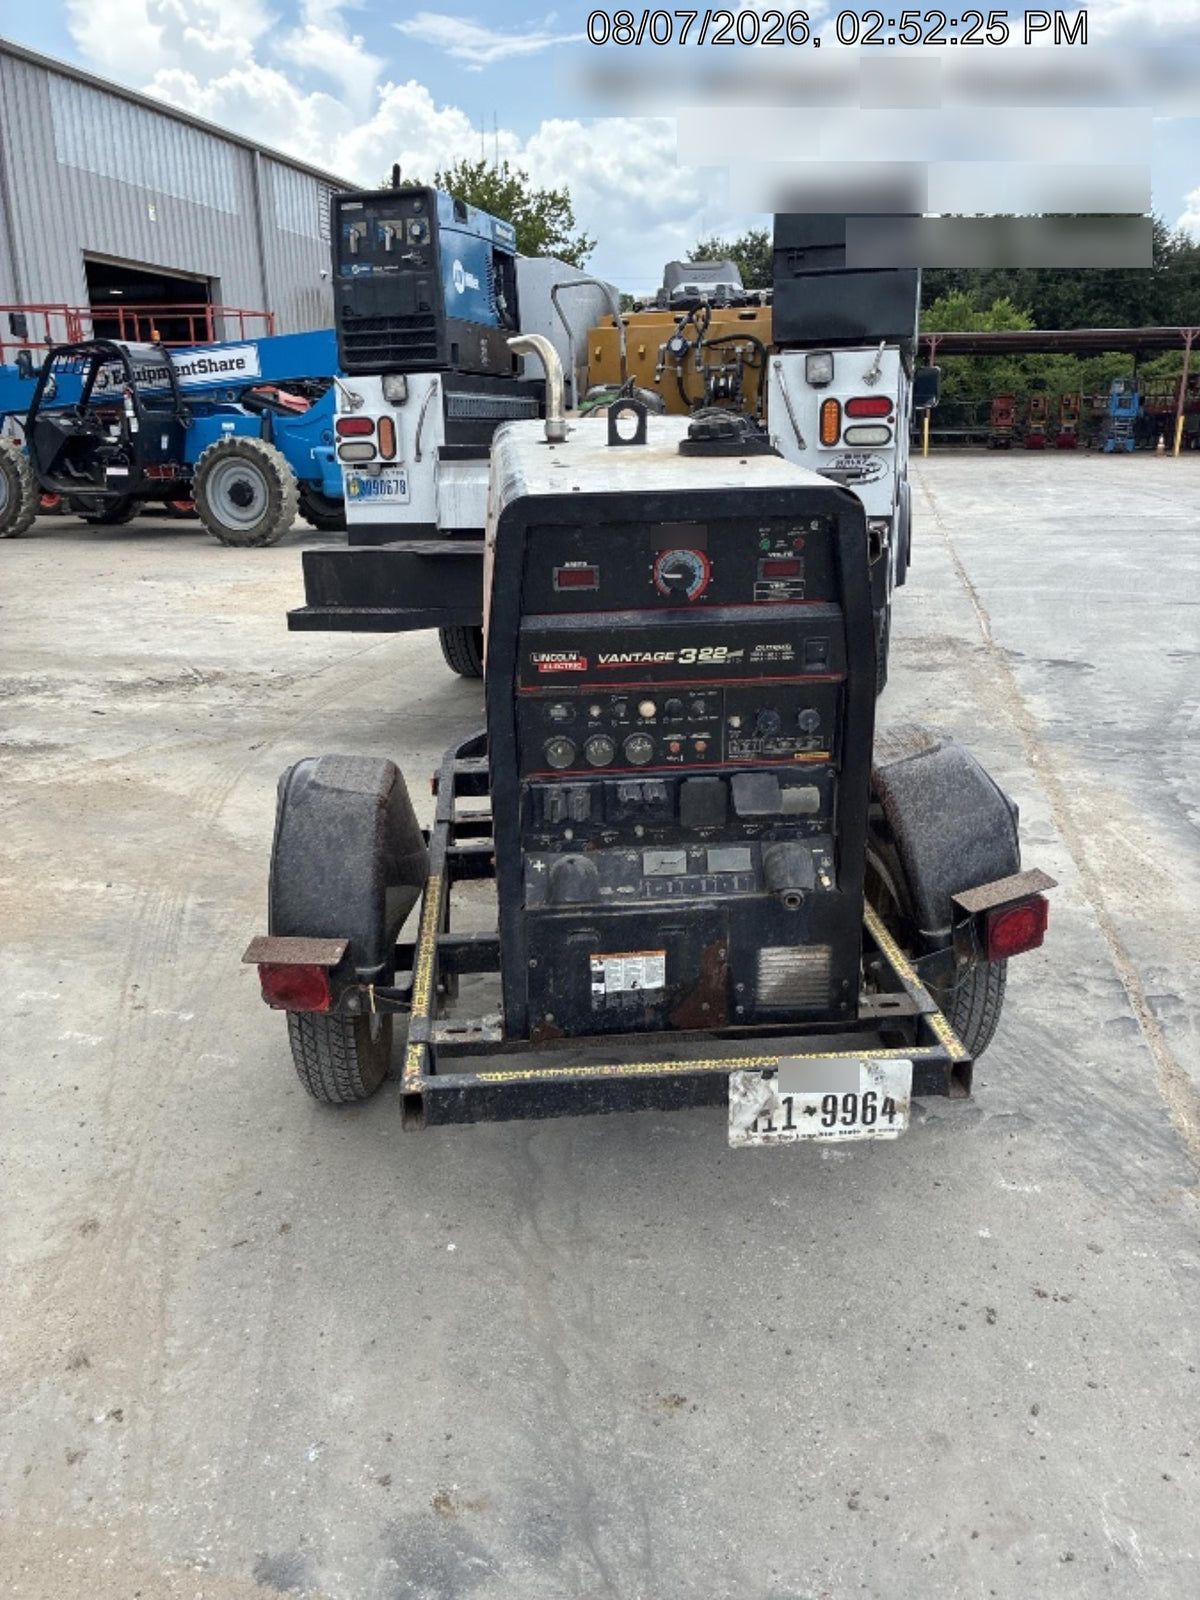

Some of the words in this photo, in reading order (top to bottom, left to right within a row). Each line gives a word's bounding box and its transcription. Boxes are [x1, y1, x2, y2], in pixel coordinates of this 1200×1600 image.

[532, 652, 578, 662] LINCOLN
[598, 652, 676, 664] VANTAGE
[678, 646, 728, 664] 322
[821, 1091, 898, 1128] 9964
